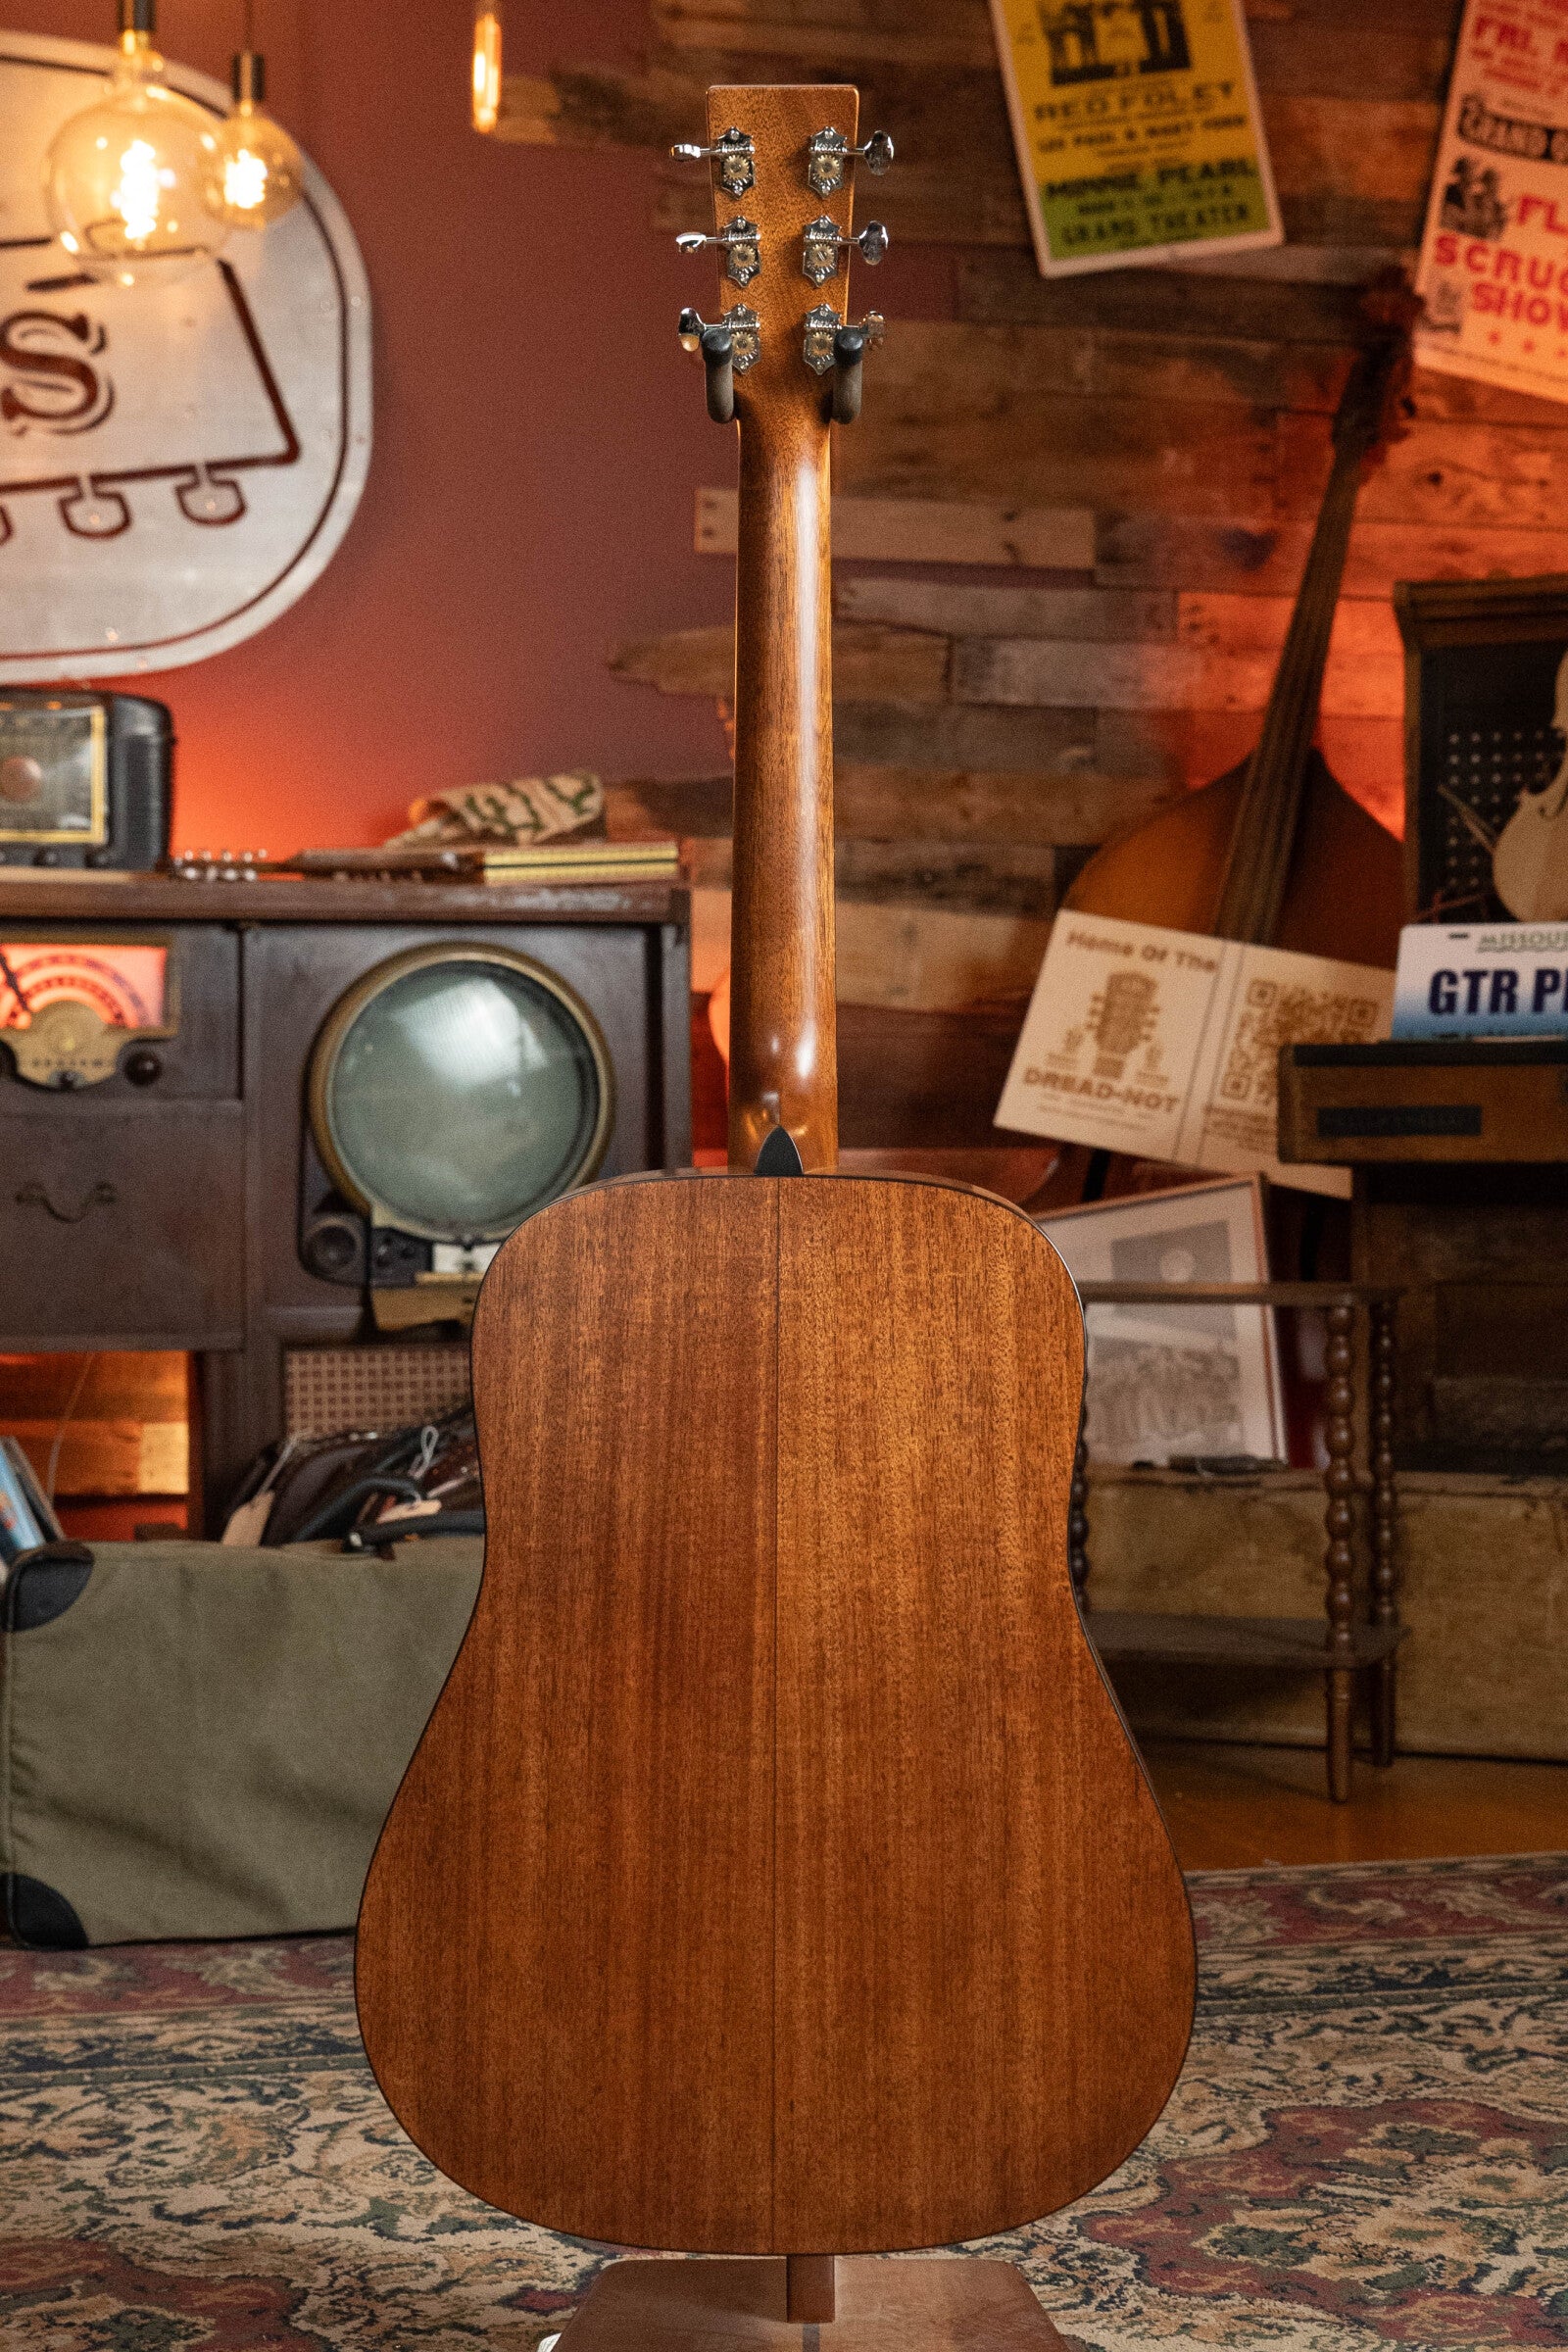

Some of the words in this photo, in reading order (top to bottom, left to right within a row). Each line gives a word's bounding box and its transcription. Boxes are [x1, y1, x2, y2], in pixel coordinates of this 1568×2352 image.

[1066, 929, 1135, 957] Home
[1428, 968, 1518, 1015] GTR
[1532, 968, 1568, 1014] P
[1023, 1067, 1180, 1114] DREAD-NOT
